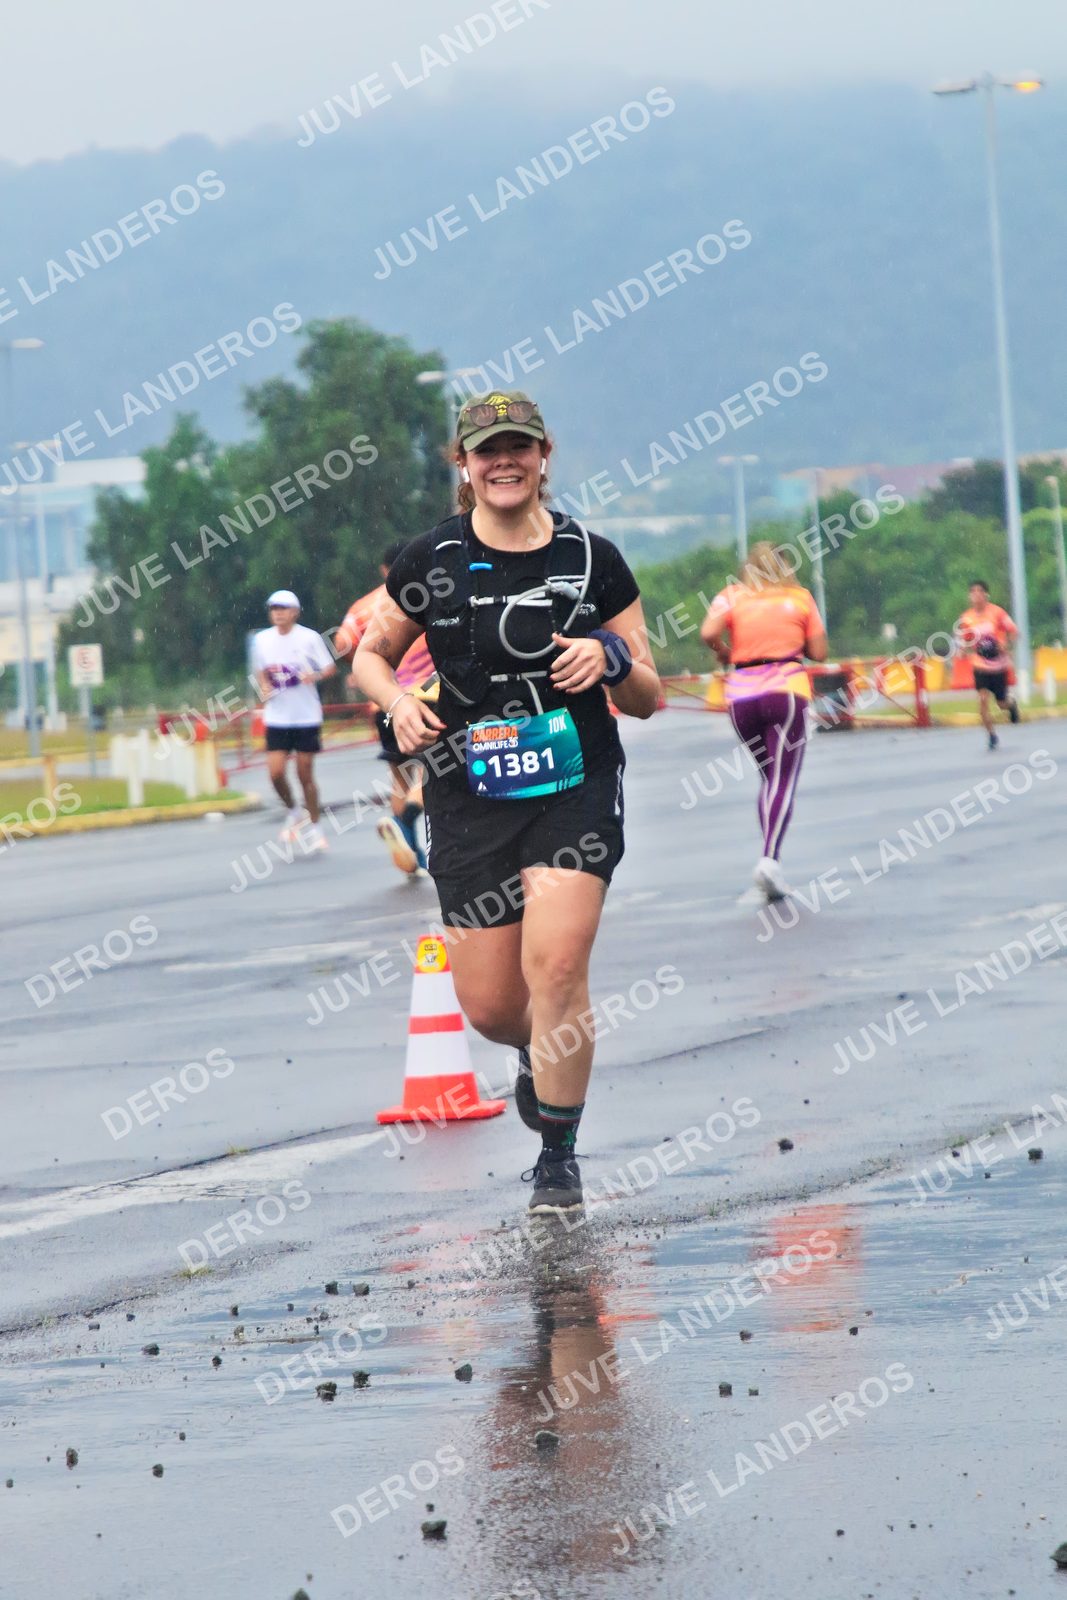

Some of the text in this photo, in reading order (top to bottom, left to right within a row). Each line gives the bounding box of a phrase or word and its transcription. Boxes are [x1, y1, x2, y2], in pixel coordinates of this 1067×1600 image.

[473, 726, 518, 743] CARRERA
[548, 714, 568, 735] 10K
[488, 747, 555, 778] 1381
